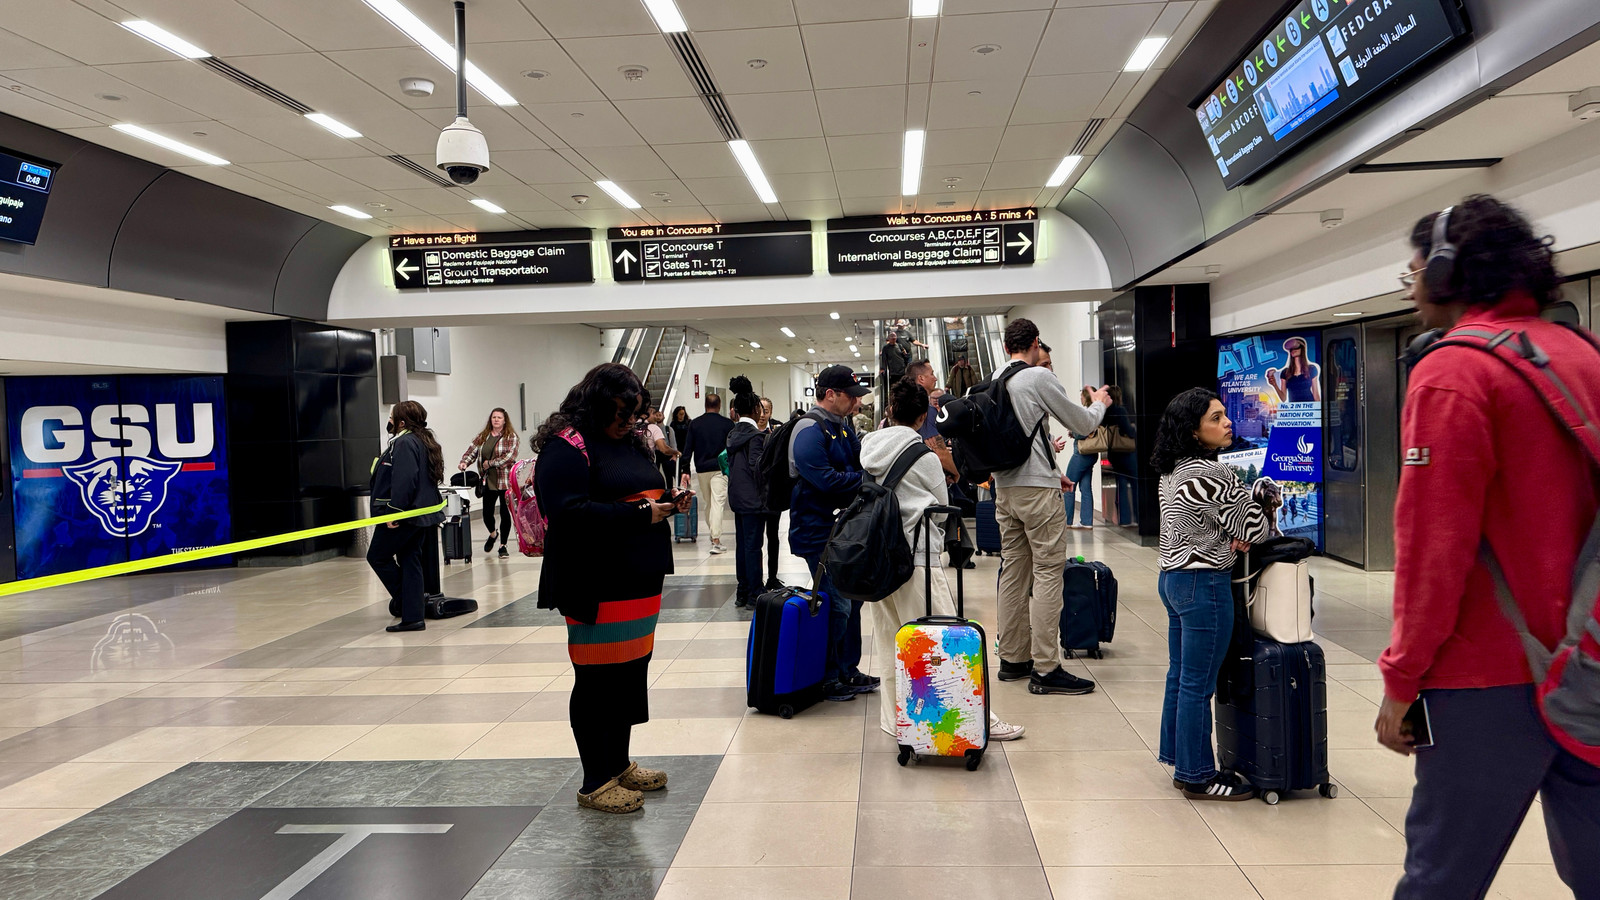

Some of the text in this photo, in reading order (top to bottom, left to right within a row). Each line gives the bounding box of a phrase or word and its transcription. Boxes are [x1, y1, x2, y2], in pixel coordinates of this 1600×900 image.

[1246, 65, 1255, 81] D
[1266, 44, 1274, 62] C
[1290, 19, 1300, 40] B
[26, 174, 40, 185] 0:48
[887, 216, 908, 225] Walk
[924, 214, 972, 223] Concourse
[974, 213, 982, 221] A
[990, 212, 996, 220] 5
[999, 211, 1021, 220] mins
[621, 228, 637, 237] You
[666, 226, 713, 235] Concourse
[715, 225, 722, 233] T
[869, 228, 981, 243] Concourses A,B,C,D,E,F
[403, 236, 424, 245] Have
[661, 241, 723, 252] Concourse T
[442, 247, 565, 260] Domestic Baggage Claim
[838, 247, 981, 263] International Baggage Claim
[444, 265, 549, 277] Ground Transportation
[663, 260, 690, 270] Gates
[692, 260, 701, 268] T1
[710, 259, 726, 268] T21
[1217, 336, 1278, 379] ATL
[21, 403, 214, 463] GSU
[1279, 462, 1314, 476] University
[275, 824, 454, 900] T
